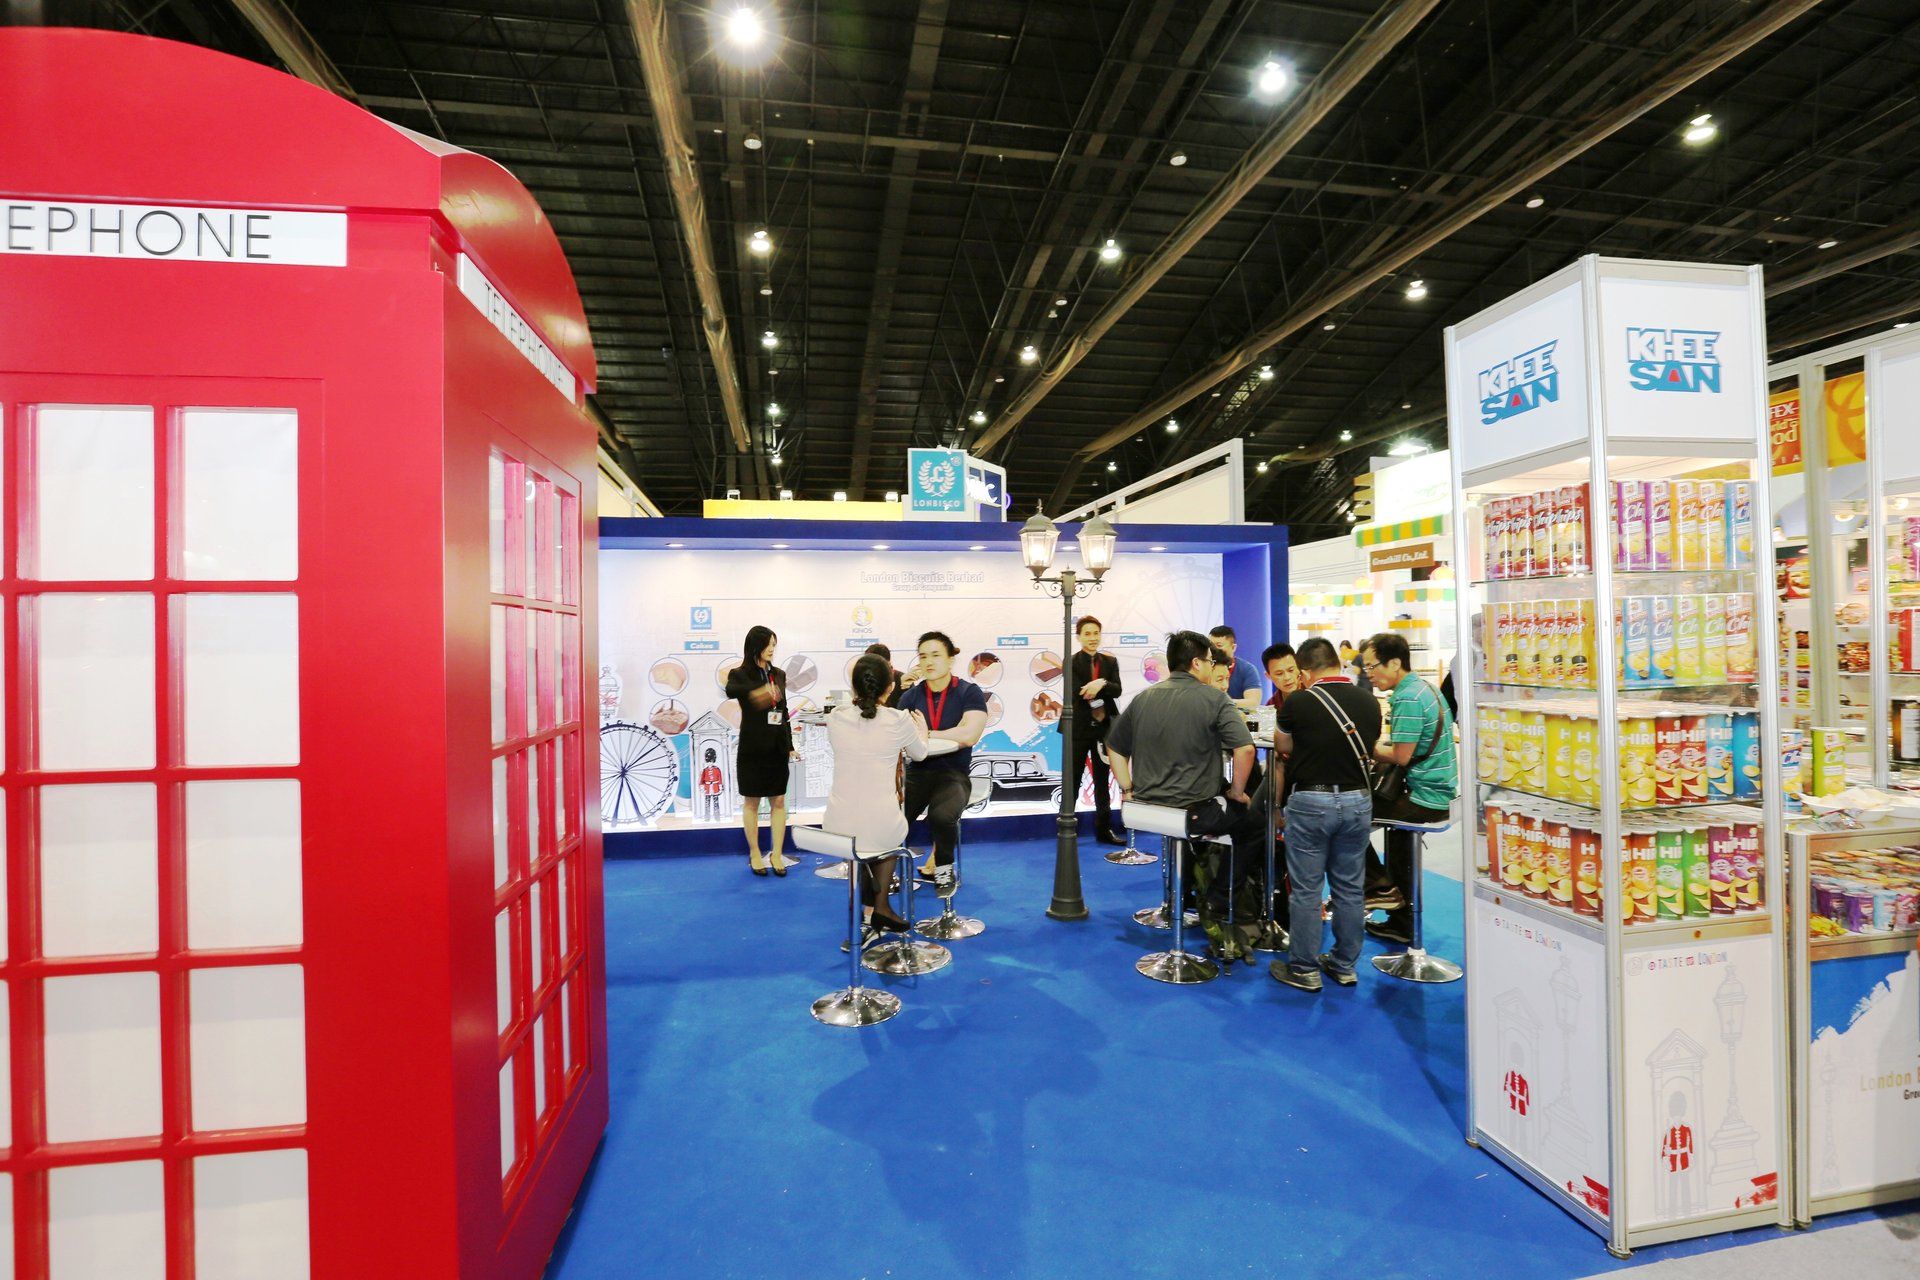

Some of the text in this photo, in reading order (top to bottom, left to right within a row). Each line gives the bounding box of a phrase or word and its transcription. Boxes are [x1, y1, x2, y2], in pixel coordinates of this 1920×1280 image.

[8, 205, 272, 259] EPHONE
[1626, 327, 1722, 363] KHEE
[1478, 338, 1559, 403] KHEE
[1629, 360, 1721, 393] SAN
[1481, 371, 1559, 425] SAN
[913, 499, 961, 508] LONBISCO
[860, 571, 985, 583] London Biscuits Berhad
